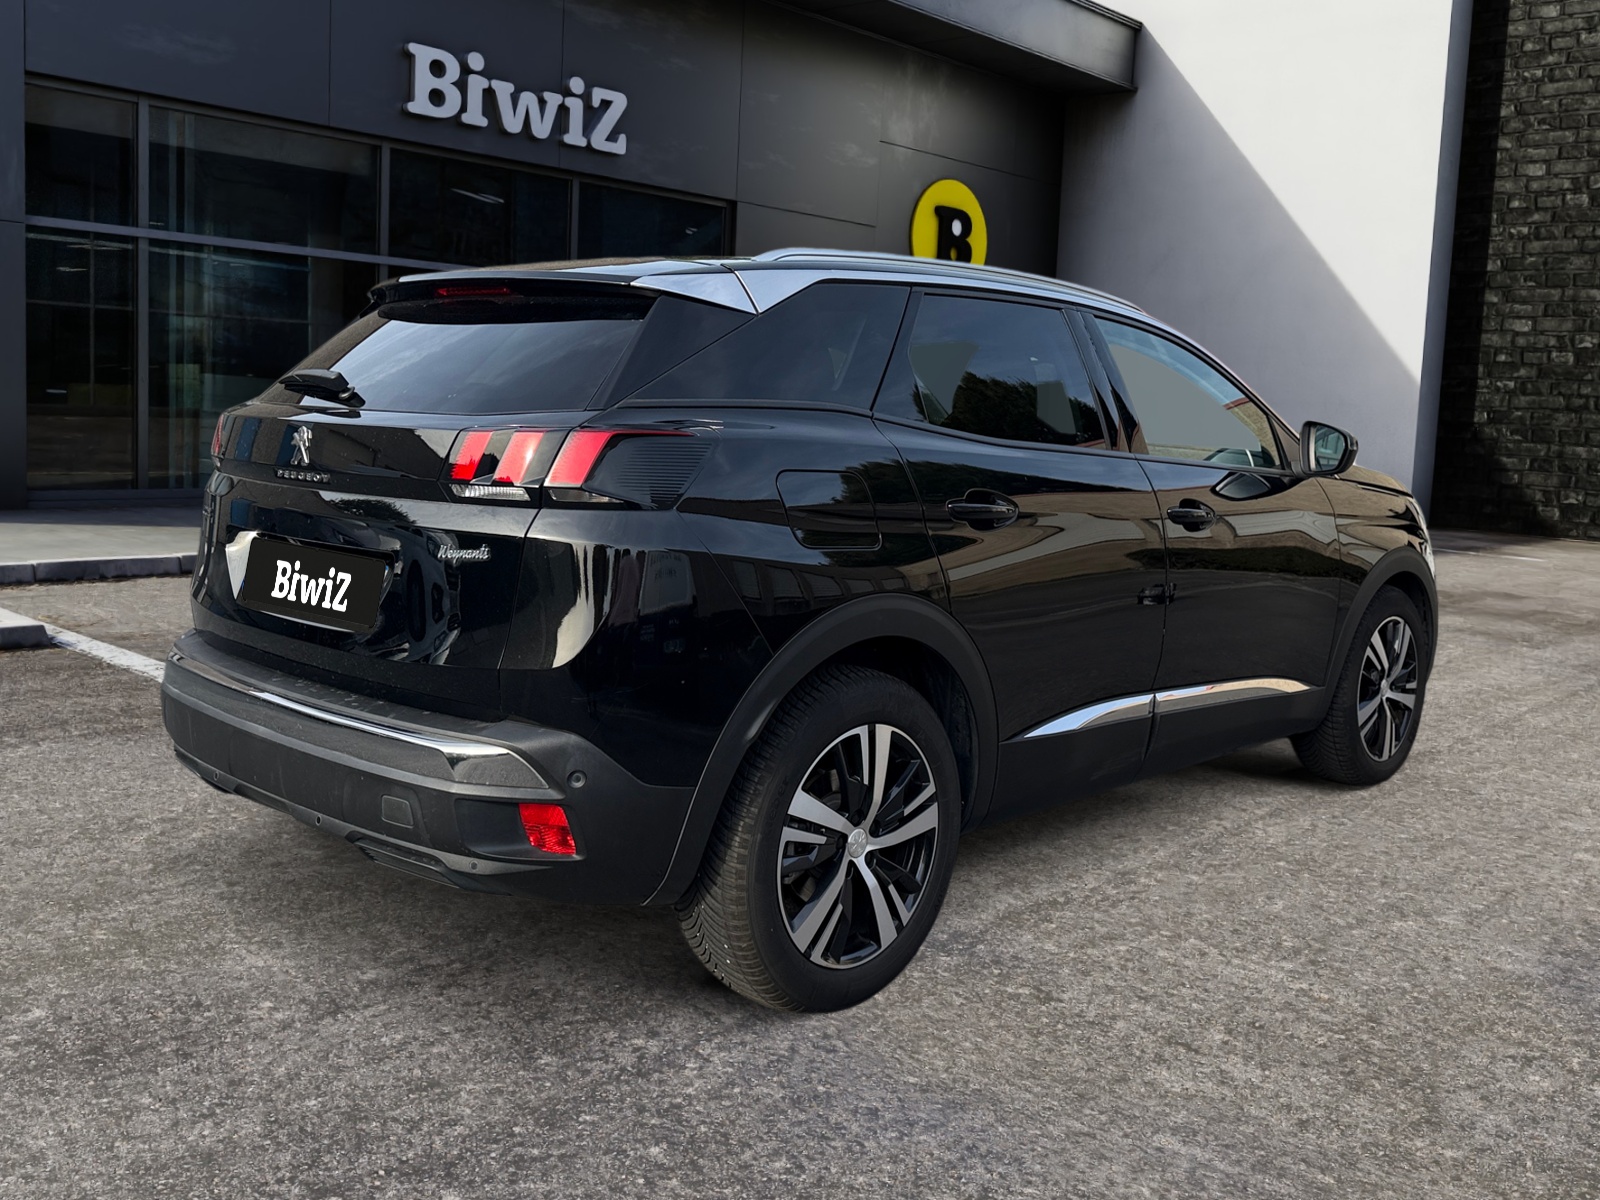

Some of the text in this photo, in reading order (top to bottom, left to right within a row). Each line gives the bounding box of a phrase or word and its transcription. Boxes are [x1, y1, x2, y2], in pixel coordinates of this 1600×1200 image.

[403, 42, 628, 155] BiwiZ
[934, 205, 973, 264] B
[276, 469, 331, 483] PEUGEOT
